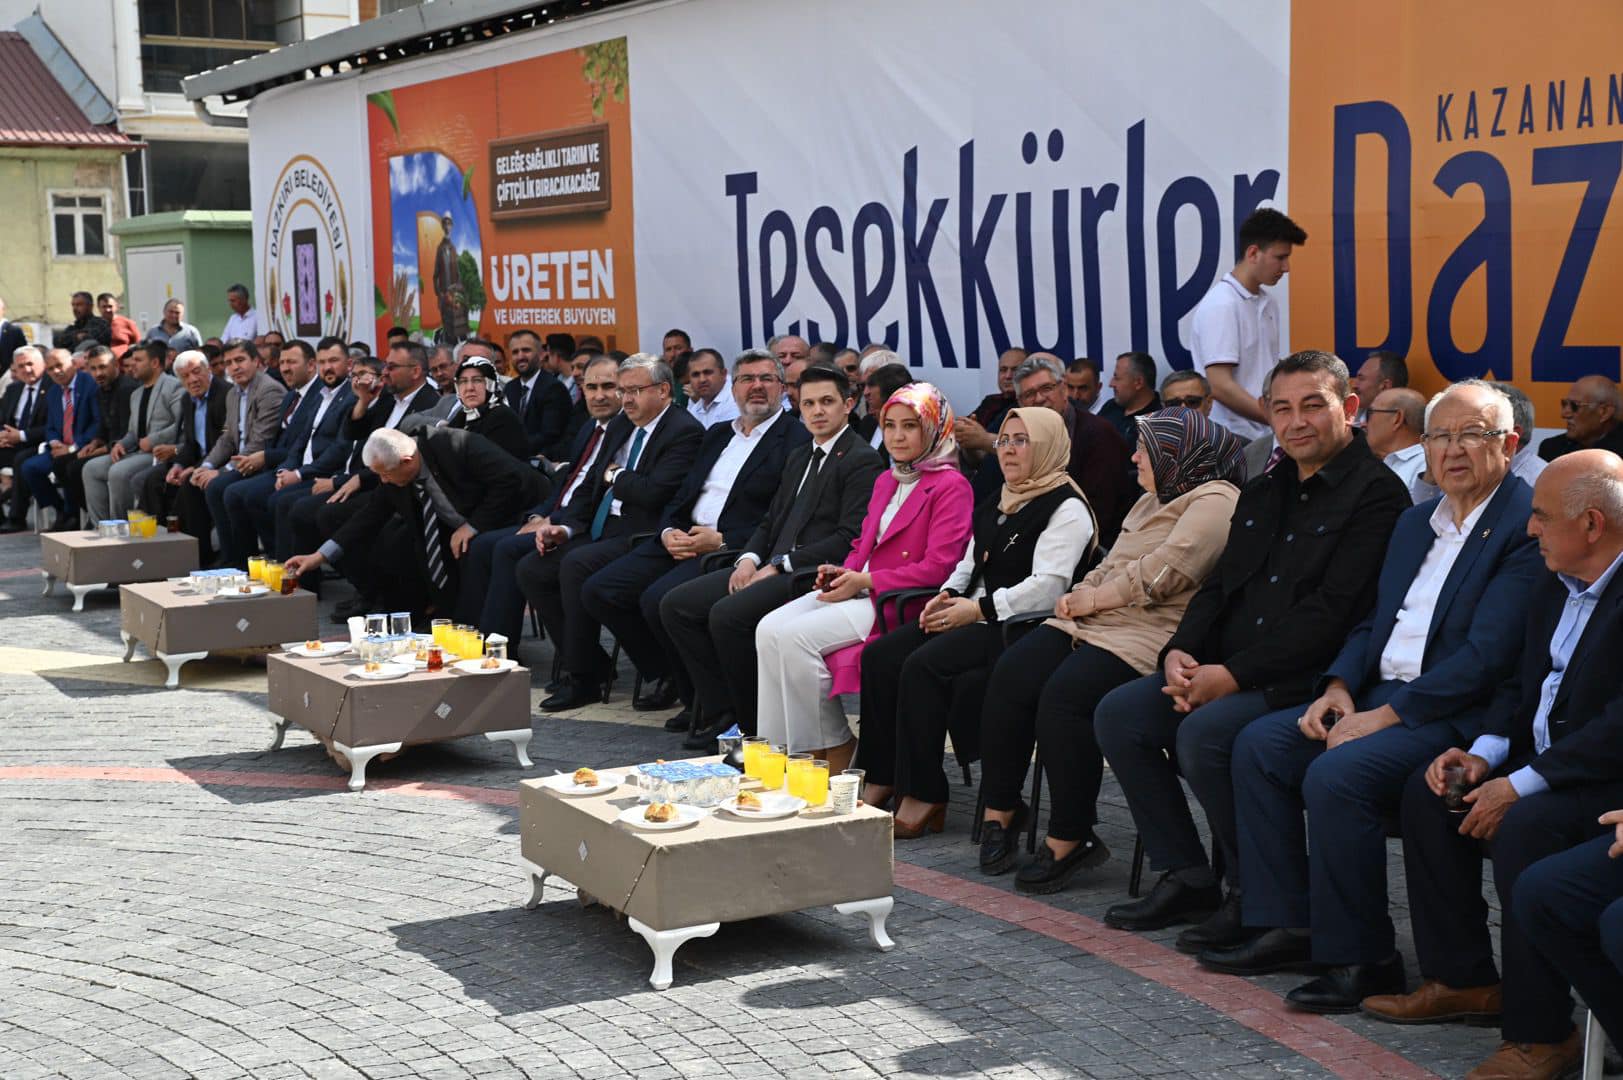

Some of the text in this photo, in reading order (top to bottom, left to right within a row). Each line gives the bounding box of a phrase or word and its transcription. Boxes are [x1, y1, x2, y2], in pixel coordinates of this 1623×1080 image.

[1436, 72, 1623, 142] KAZANAN
[525, 147, 561, 171] SAĞLIKLI
[561, 145, 588, 167] TARIM
[588, 143, 600, 162] VE
[1332, 100, 1622, 383] Daz
[494, 308, 508, 325] VE
